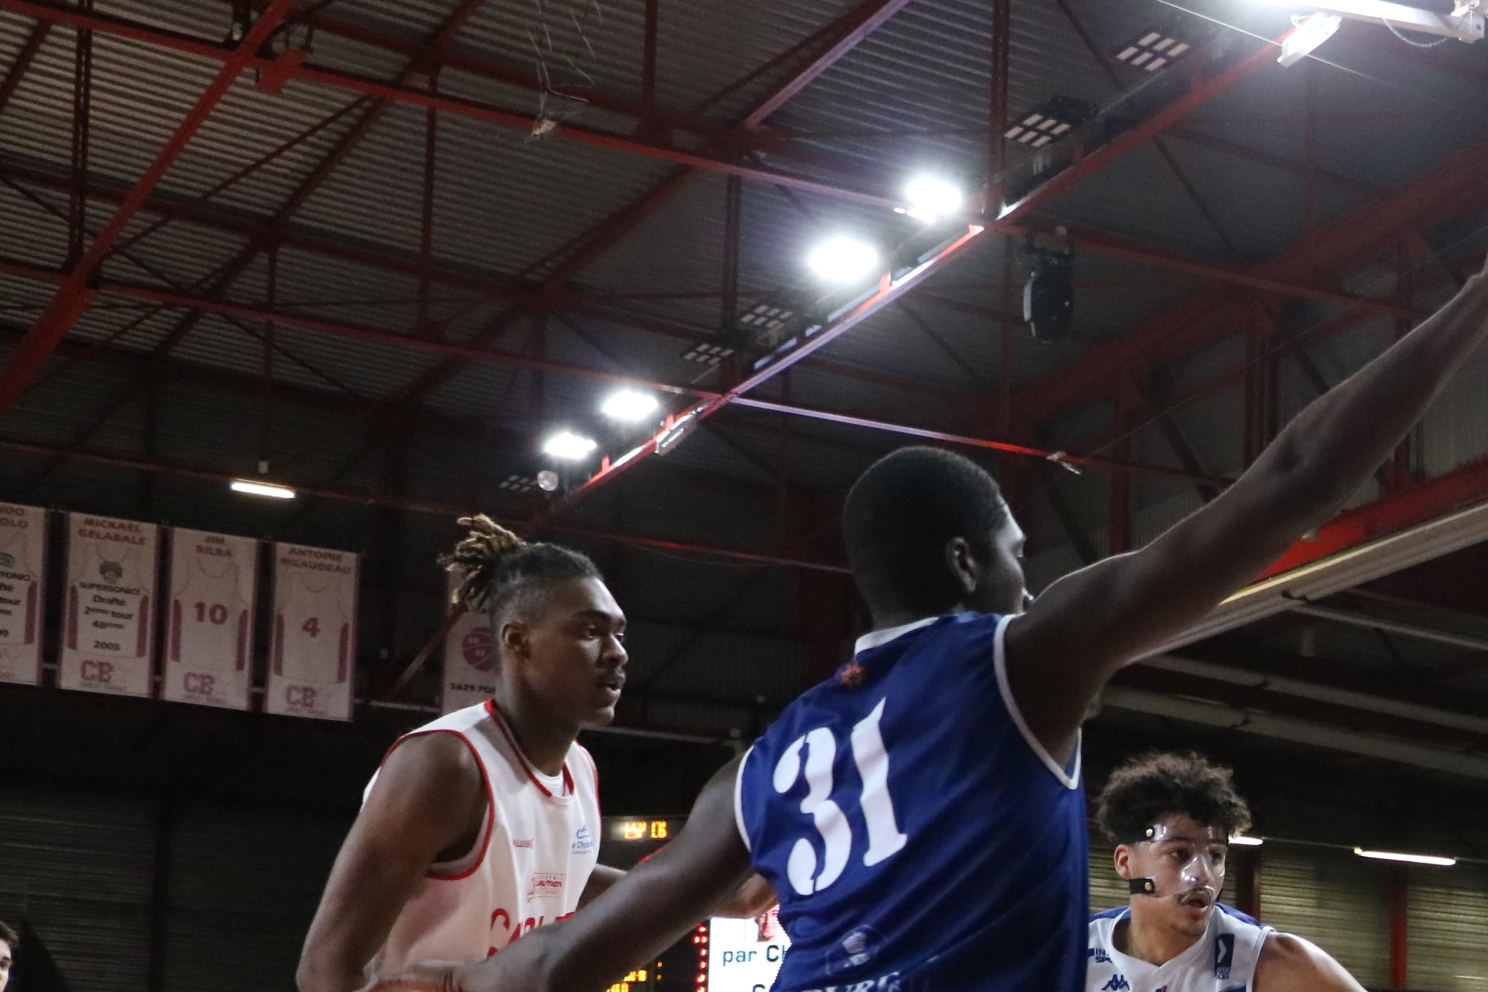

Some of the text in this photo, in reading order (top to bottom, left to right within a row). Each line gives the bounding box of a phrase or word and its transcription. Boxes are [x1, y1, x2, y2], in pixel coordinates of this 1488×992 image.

[288, 547, 343, 562] ANTOINE
[279, 557, 351, 575] RIGAUDEAU
[79, 581, 141, 596] SUPERSONICS
[194, 601, 229, 625] 10
[302, 616, 320, 638] 4
[80, 659, 114, 684] CB
[183, 672, 216, 695] CB
[286, 684, 317, 708] CB
[773, 696, 908, 896] 31
[722, 949, 757, 967] par
